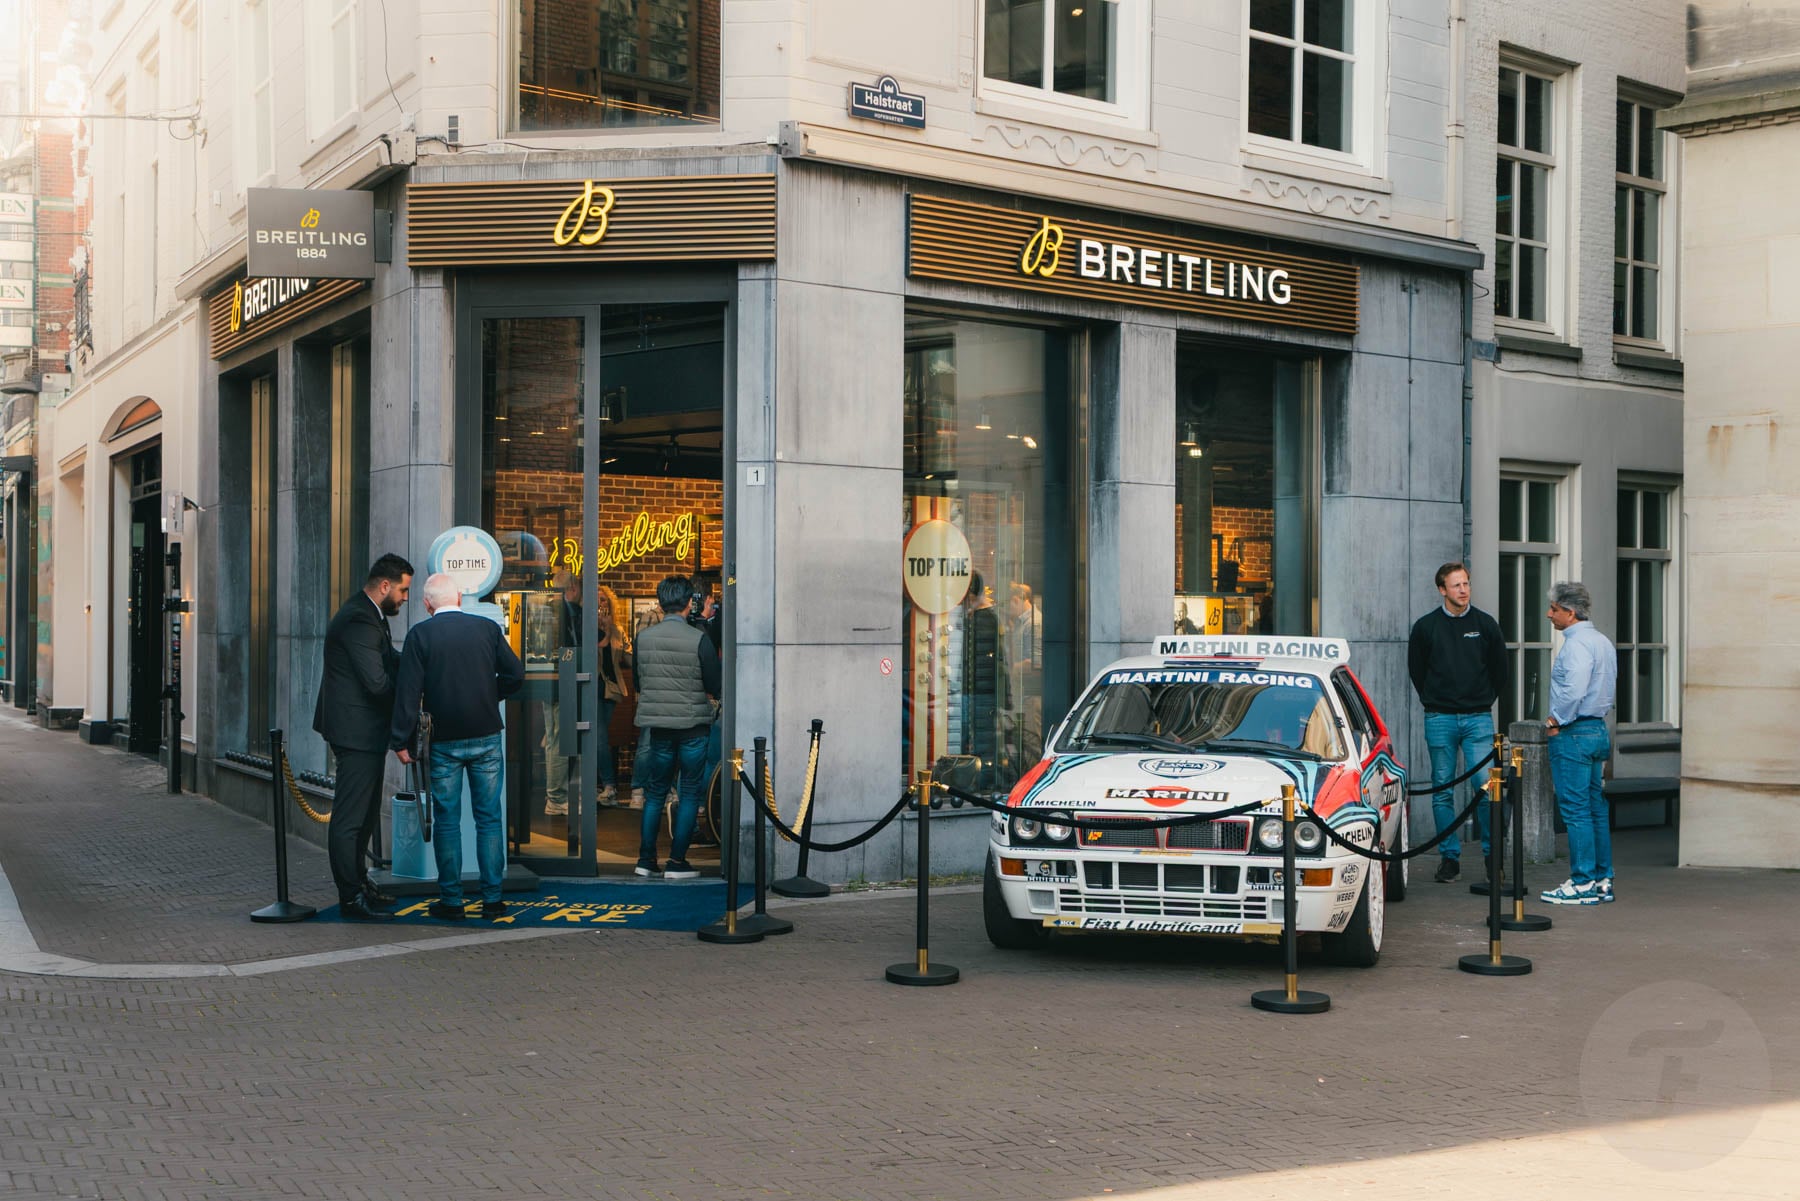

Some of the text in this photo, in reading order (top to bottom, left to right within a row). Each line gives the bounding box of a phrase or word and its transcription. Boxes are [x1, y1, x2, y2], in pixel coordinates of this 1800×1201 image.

[865, 91, 912, 112] Halstraat
[256, 230, 367, 246] BREITLING
[296, 248, 327, 259] 1884
[1080, 239, 1291, 305] BREITLING
[753, 469, 759, 482] 1
[447, 558, 486, 569] TOP TIME
[908, 557, 969, 577] TOP TIME
[1160, 641, 1340, 659] MARTINI RACING
[1109, 672, 1313, 689] MARTINI RACING
[1110, 789, 1225, 801] MARTINI
[1336, 891, 1356, 902] WEBER
[1082, 917, 1241, 934] Fiat Lubrificanti
